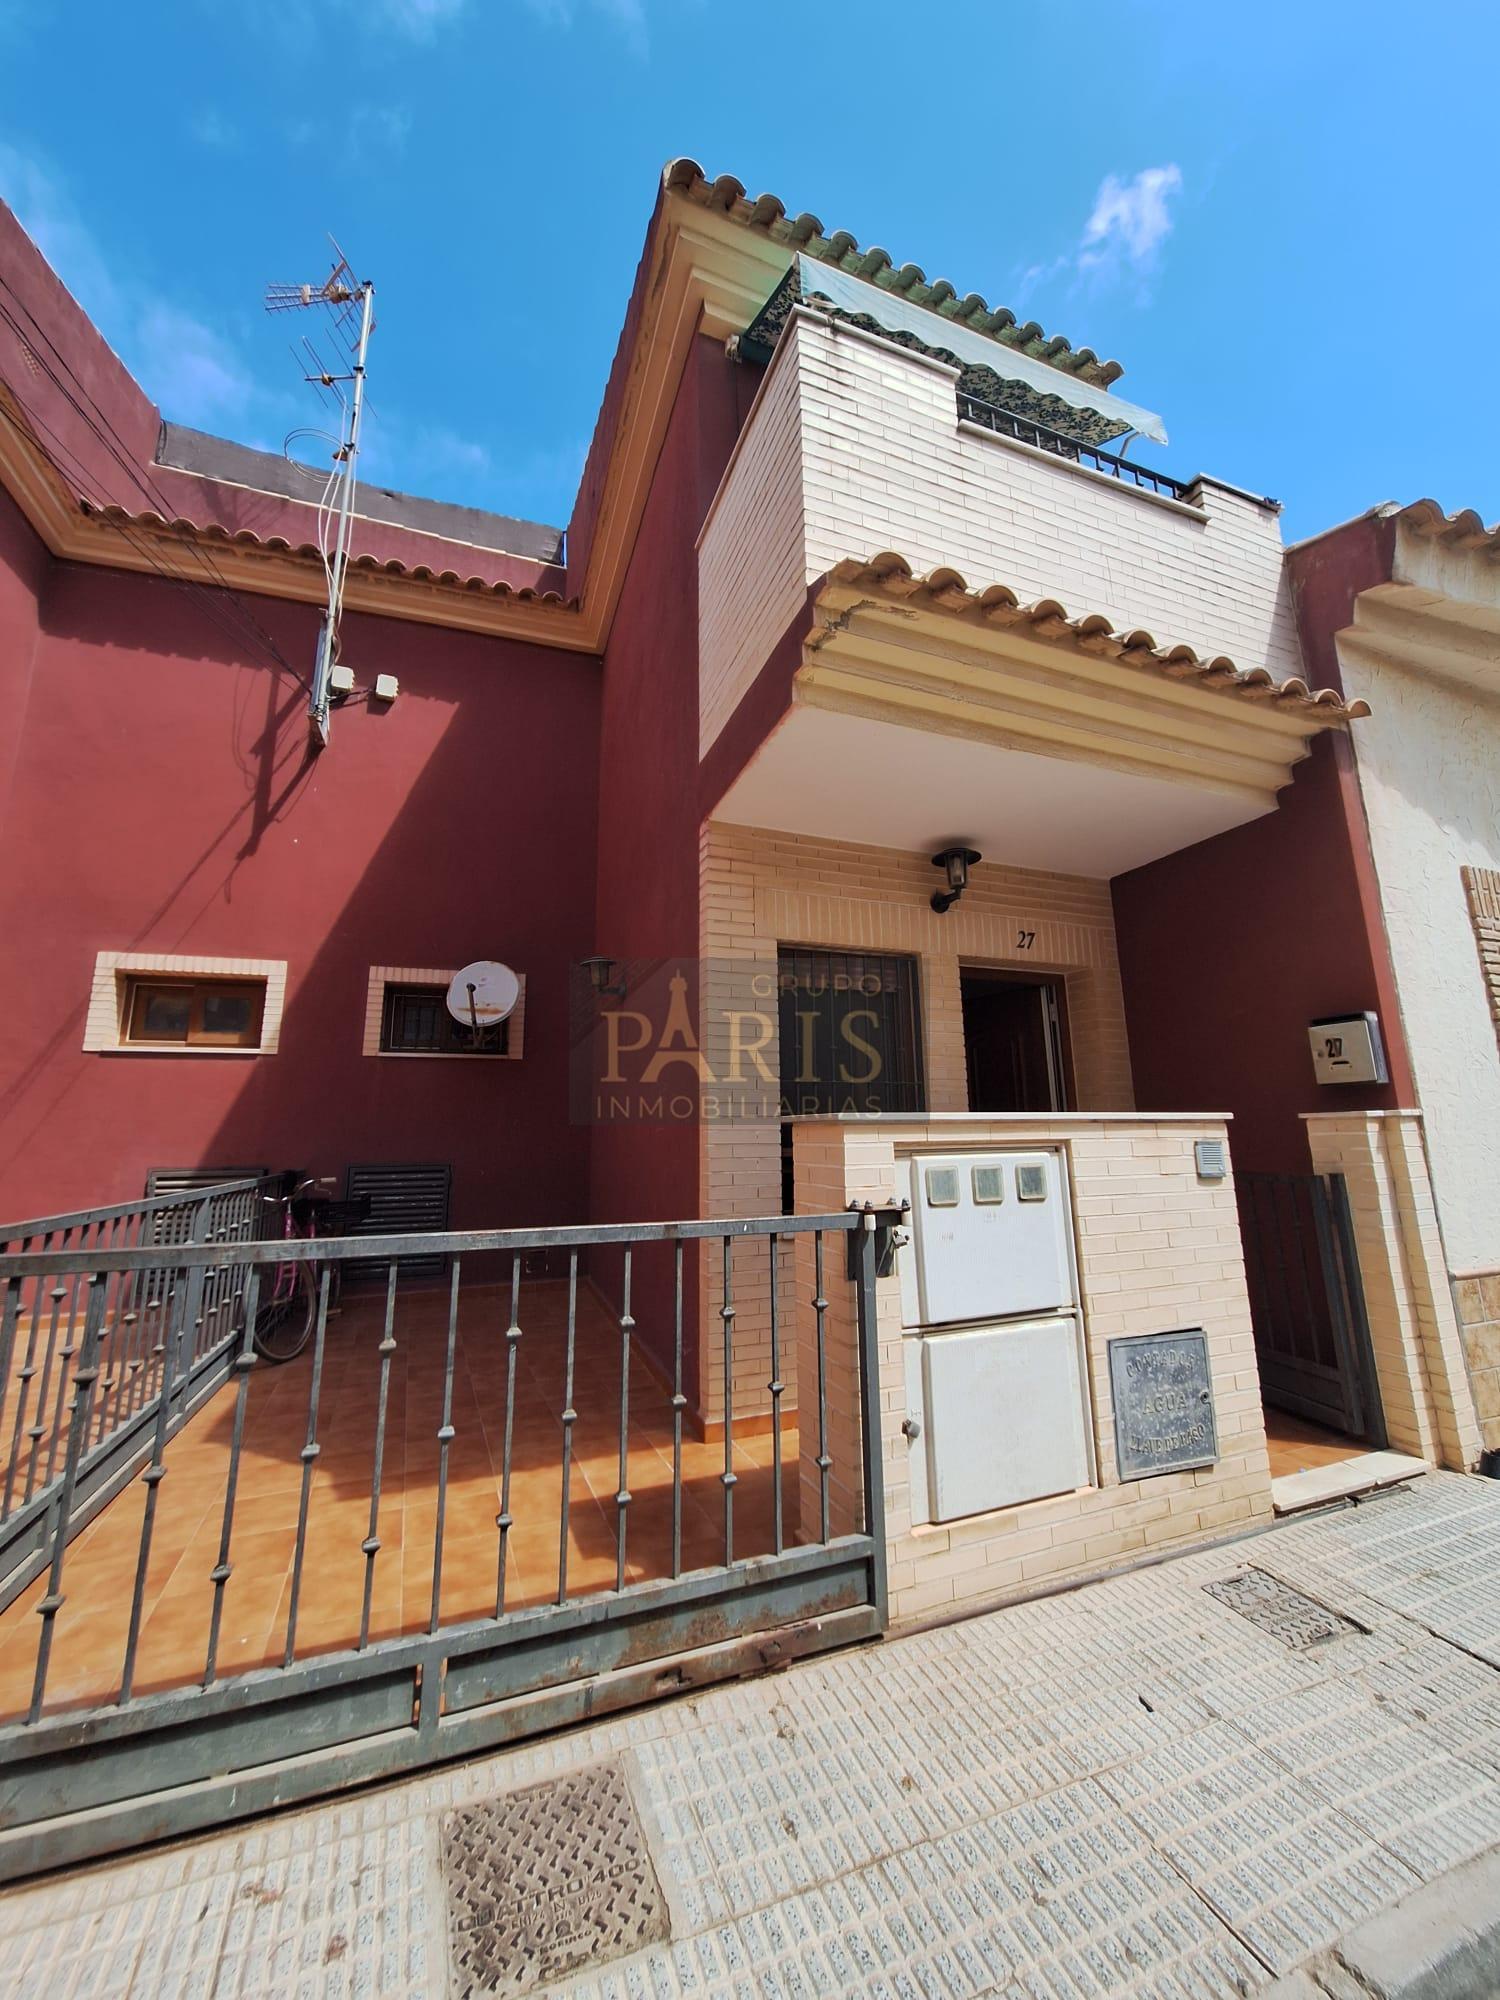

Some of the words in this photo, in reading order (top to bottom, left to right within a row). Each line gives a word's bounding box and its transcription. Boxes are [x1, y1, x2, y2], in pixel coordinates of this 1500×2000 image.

[1016, 930, 1036, 950] 27
[1325, 1038, 1343, 1058] 27
[1142, 1391, 1188, 1415] AGUA
